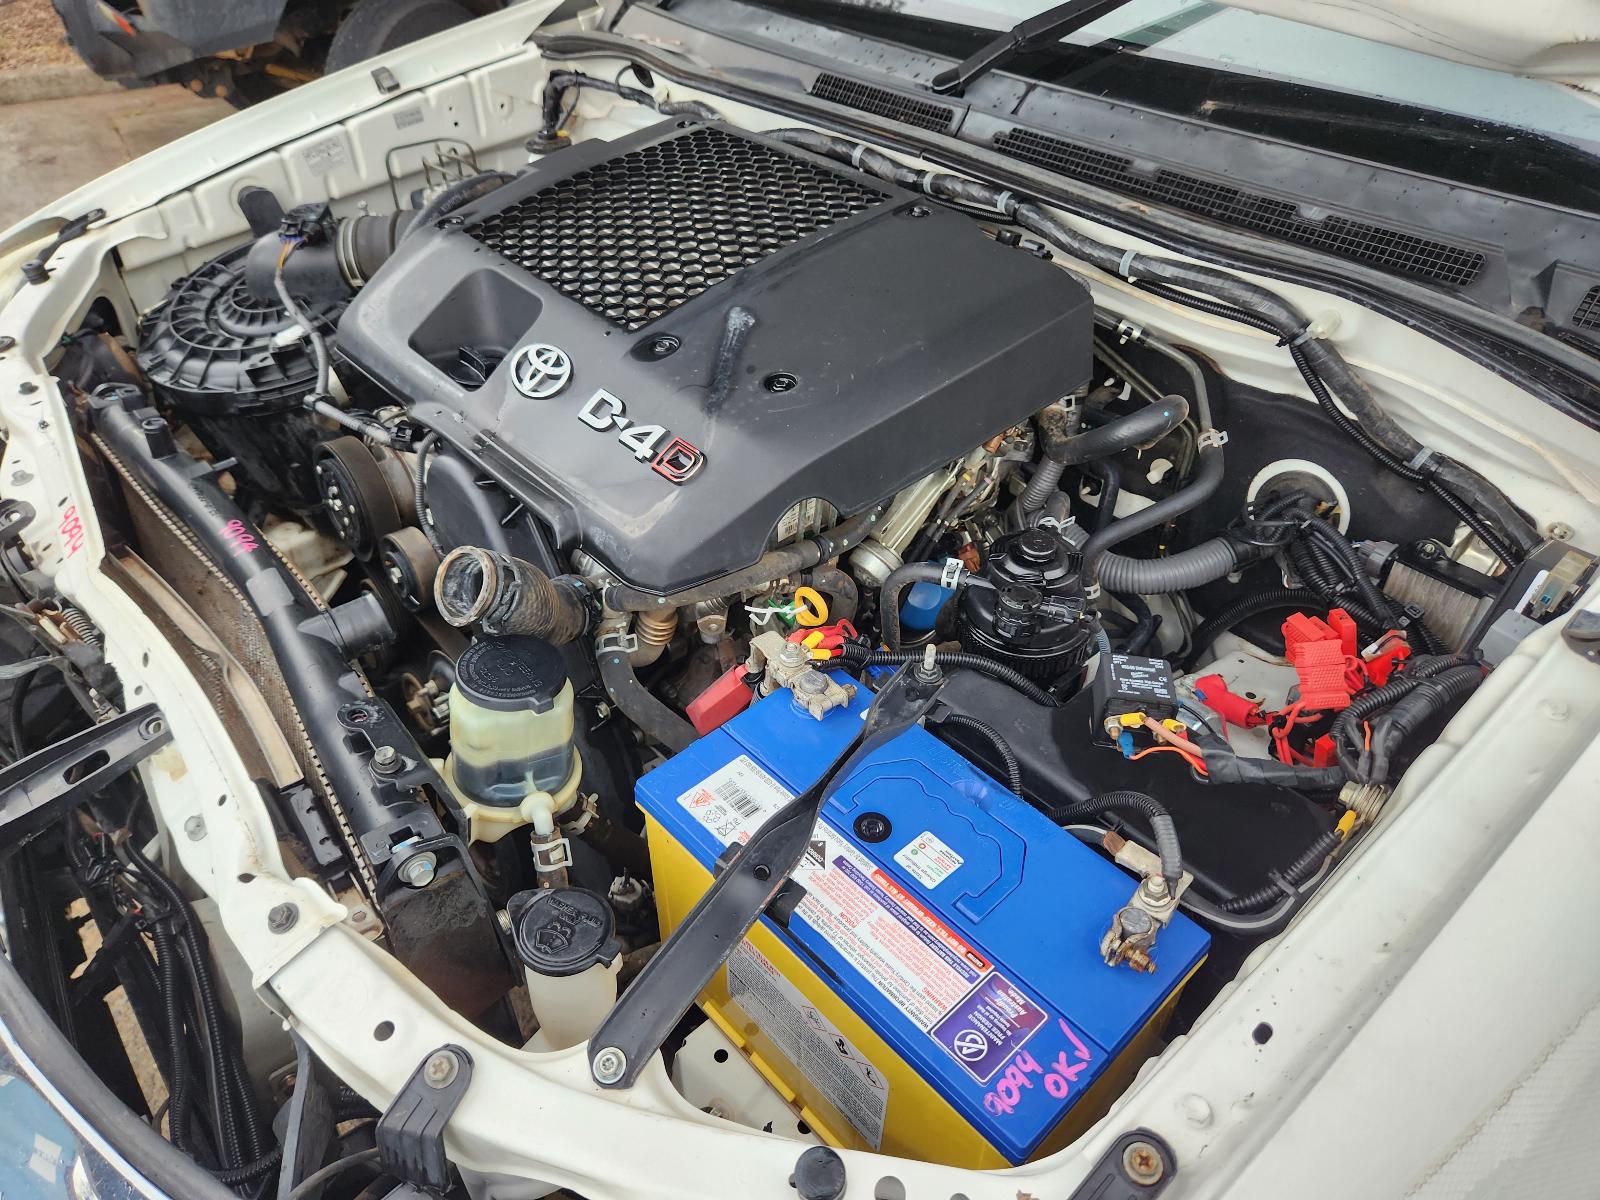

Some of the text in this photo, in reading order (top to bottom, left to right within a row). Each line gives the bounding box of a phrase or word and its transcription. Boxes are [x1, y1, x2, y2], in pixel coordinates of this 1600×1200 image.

[806, 847, 824, 862] CORRO
[888, 886, 898, 894] ALL
[896, 892, 904, 900] AT
[902, 898, 924, 916] UPRIGHT
[837, 911, 857, 928] POISON
[922, 915, 936, 927] KEEP
[946, 935, 959, 946] NOT
[956, 944, 966, 952] DO
[876, 980, 906, 1006] INFORMATION
[920, 986, 948, 1011] WARNING
[1006, 988, 1025, 1005] Made
[993, 997, 1018, 1019] Proudly
[995, 988, 1027, 1016] Australian
[903, 1005, 929, 1028] WARRANTY
[966, 1013, 1004, 1046] MAINTENANCE
[990, 1025, 1005, 1039] FREE
[1043, 1050, 1089, 1099] OK
